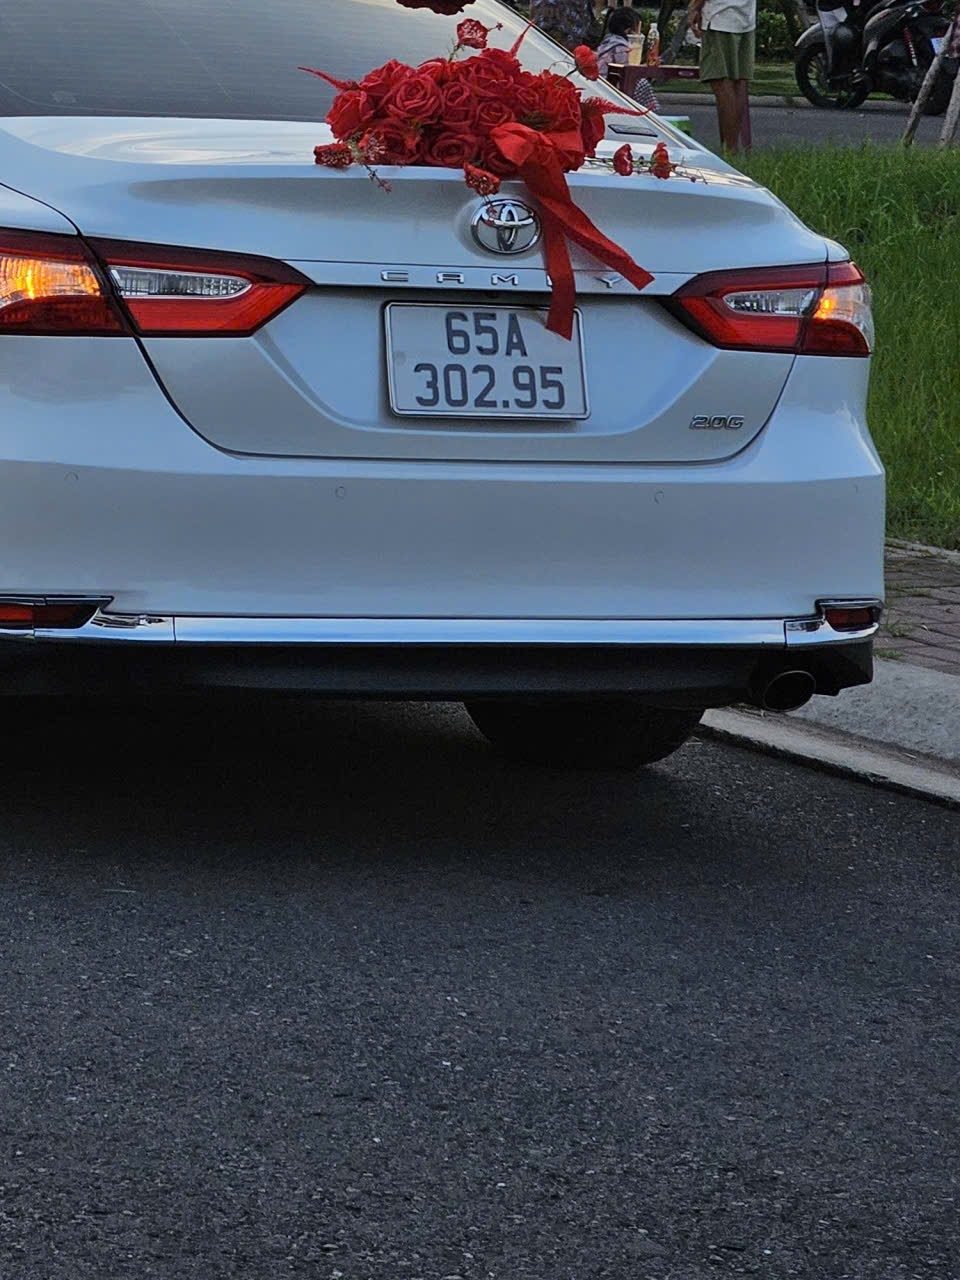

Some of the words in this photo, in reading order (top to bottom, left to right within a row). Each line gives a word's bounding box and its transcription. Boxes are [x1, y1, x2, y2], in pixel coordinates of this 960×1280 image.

[380, 270, 623, 289] CAMY
[445, 311, 528, 357] 65A
[414, 362, 566, 410] 302.95
